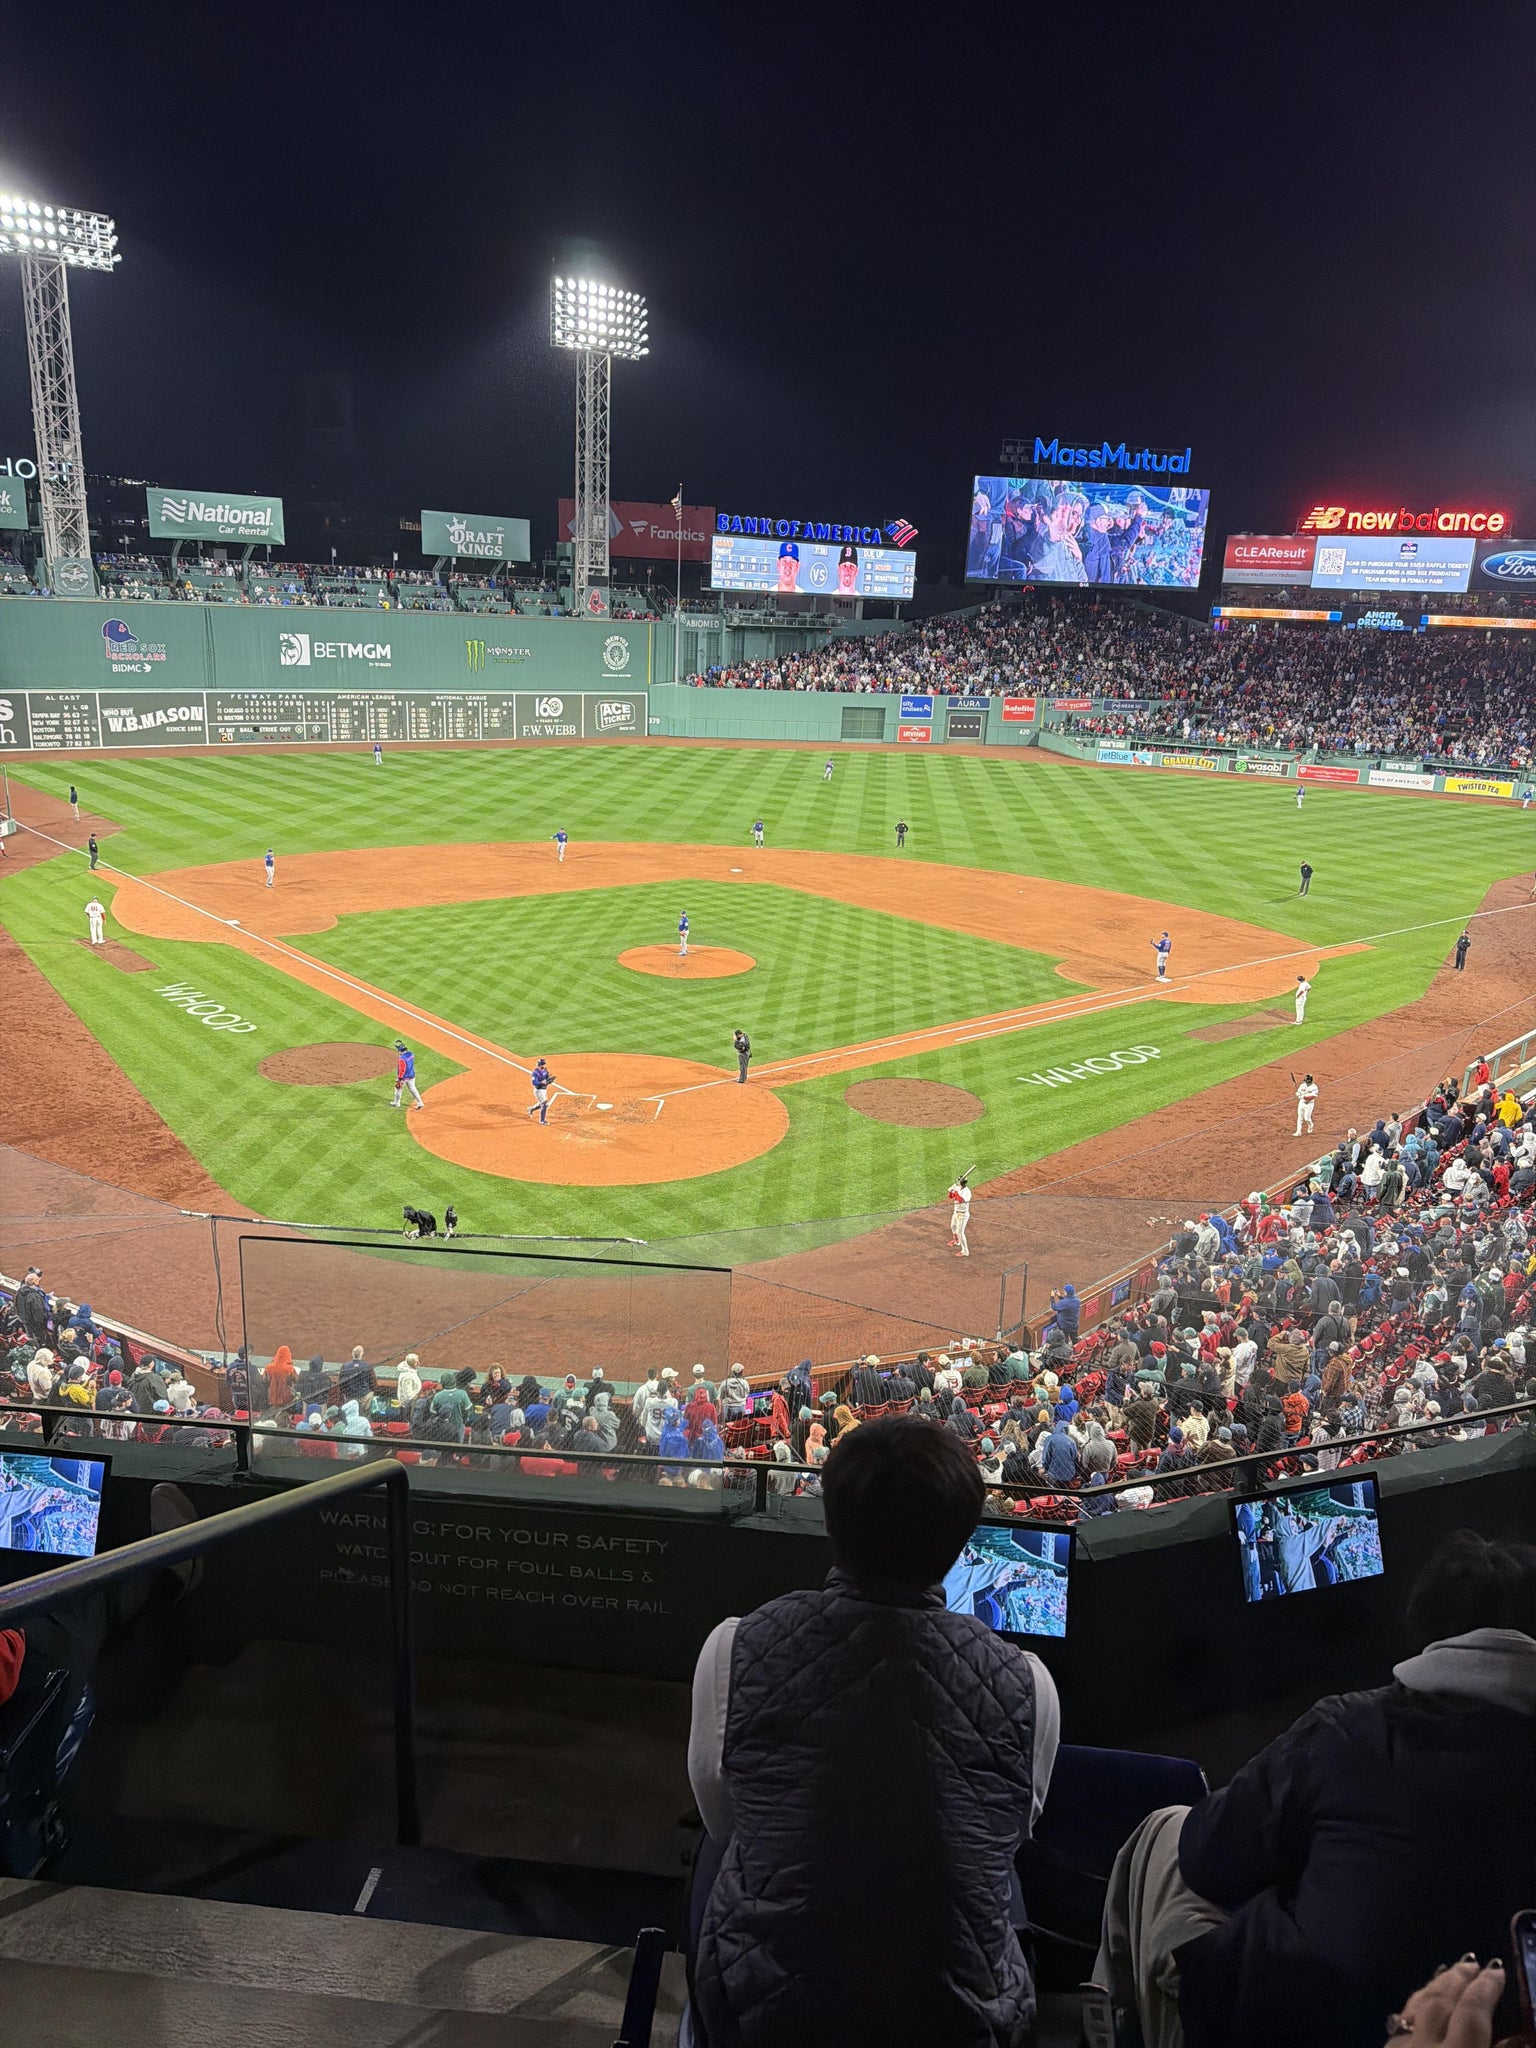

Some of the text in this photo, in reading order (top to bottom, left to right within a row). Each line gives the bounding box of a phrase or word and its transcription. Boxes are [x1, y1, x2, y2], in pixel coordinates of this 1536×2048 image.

[1033, 437, 1192, 474] MassMutual
[1347, 511, 1397, 531] new
[1399, 507, 1504, 532] balance
[218, 525, 269, 536] Car Rental
[650, 525, 706, 542] Fanatics
[717, 513, 882, 544] BANK OF AMERICA
[449, 529, 505, 545] DRAFT
[456, 541, 503, 556] KINGS
[1234, 546, 1306, 558] CLEAResult
[1498, 554, 1536, 576] For
[813, 570, 826, 581] VS
[1365, 611, 1398, 619] ANGRY
[686, 620, 720, 628] ABIOMED
[1357, 618, 1404, 626] ORCHARD
[111, 643, 166, 653] RED SOX
[314, 642, 391, 659] BETMGM
[486, 646, 531, 657] MONSTER
[111, 652, 167, 661] SCHOLARS
[112, 664, 142, 673] BIDMC
[102, 709, 119, 717] WHO
[603, 703, 631, 716] ACE
[1004, 704, 1034, 712] Safelite
[604, 714, 631, 724] TICKET
[544, 724, 576, 735] WEBB
[220, 733, 233, 742] 20
[1101, 751, 1128, 760] jetBlue
[1163, 756, 1198, 766] GRANITE
[1199, 758, 1217, 769] CITY
[1248, 763, 1281, 772] wasabi
[1457, 783, 1500, 794] TWISTED TEA
[154, 982, 257, 1033] WHOOP
[1016, 1045, 1161, 1088] WHOOP
[440, 1524, 492, 1542] FOR
[498, 1528, 568, 1548] YOUR
[576, 1534, 670, 1554] SAFETY
[410, 1551, 451, 1566] OUT
[457, 1555, 499, 1570] FOR
[507, 1561, 563, 1577] FOUL
[569, 1566, 634, 1582] BALLS
[642, 1571, 654, 1583] &
[440, 1584, 480, 1598] NOT
[486, 1587, 555, 1604] REACH
[562, 1594, 619, 1610] OVER
[626, 1599, 671, 1615] RAIL
